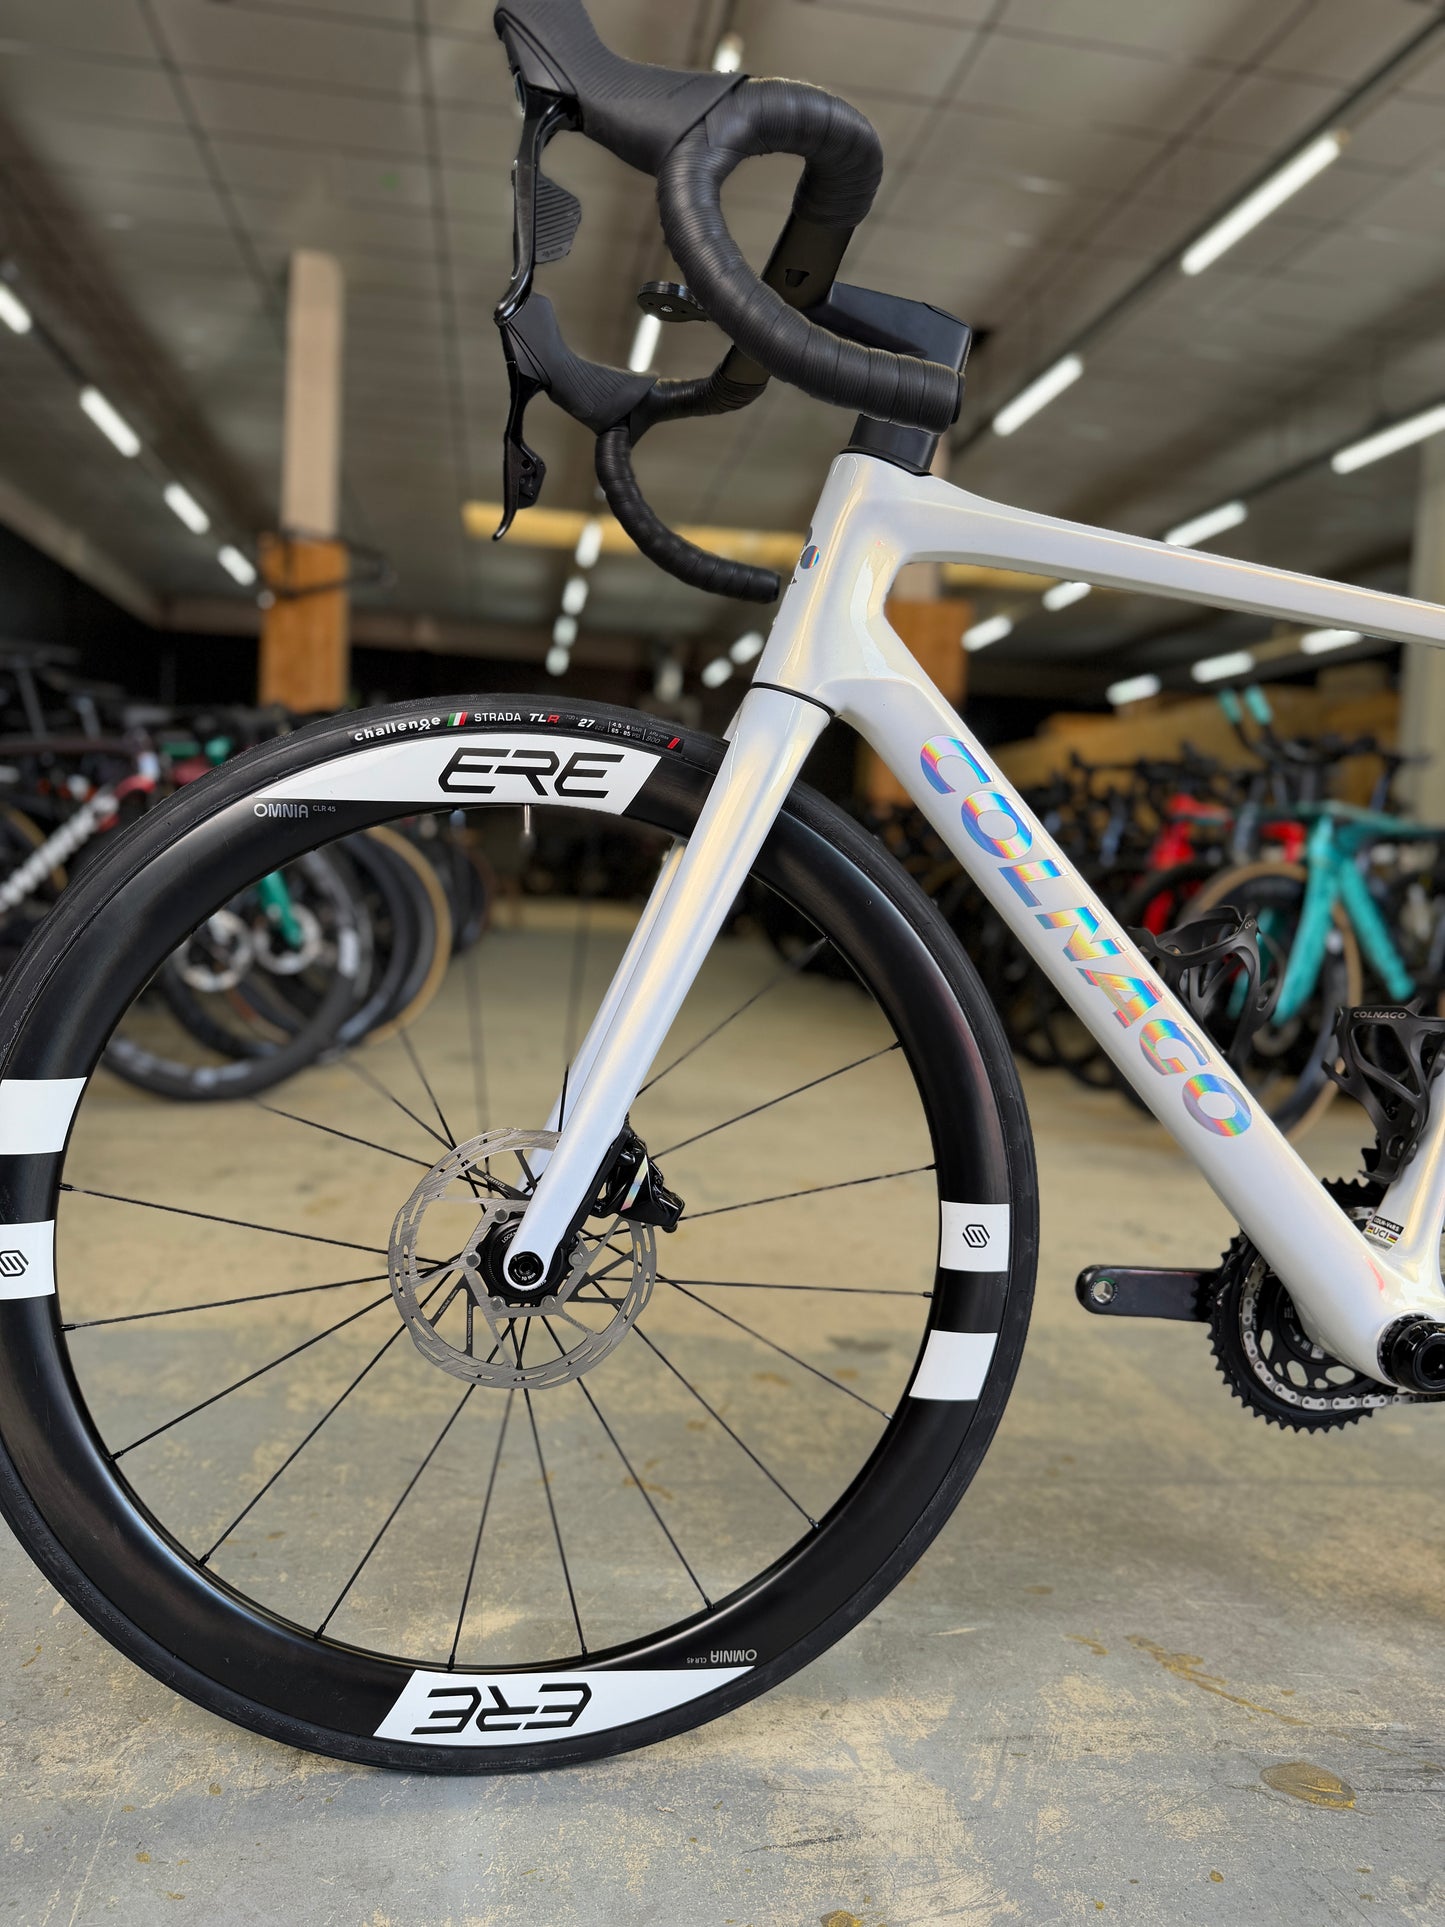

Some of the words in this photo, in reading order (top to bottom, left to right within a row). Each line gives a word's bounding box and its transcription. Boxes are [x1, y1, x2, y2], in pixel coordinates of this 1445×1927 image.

[354, 716, 441, 741] challenge
[474, 712, 522, 722] STRADA
[529, 713, 560, 723] TLR
[577, 718, 596, 728] 27
[438, 747, 625, 799] ERE
[253, 803, 309, 818] OMNIA
[919, 735, 1252, 1137] COLNAGO
[1353, 1011, 1408, 1019] COLNAGO
[1372, 1226, 1390, 1239] UCI
[686, 1656, 694, 1664] 45
[710, 1649, 758, 1663] OMNIA
[410, 1682, 593, 1735] ERE
